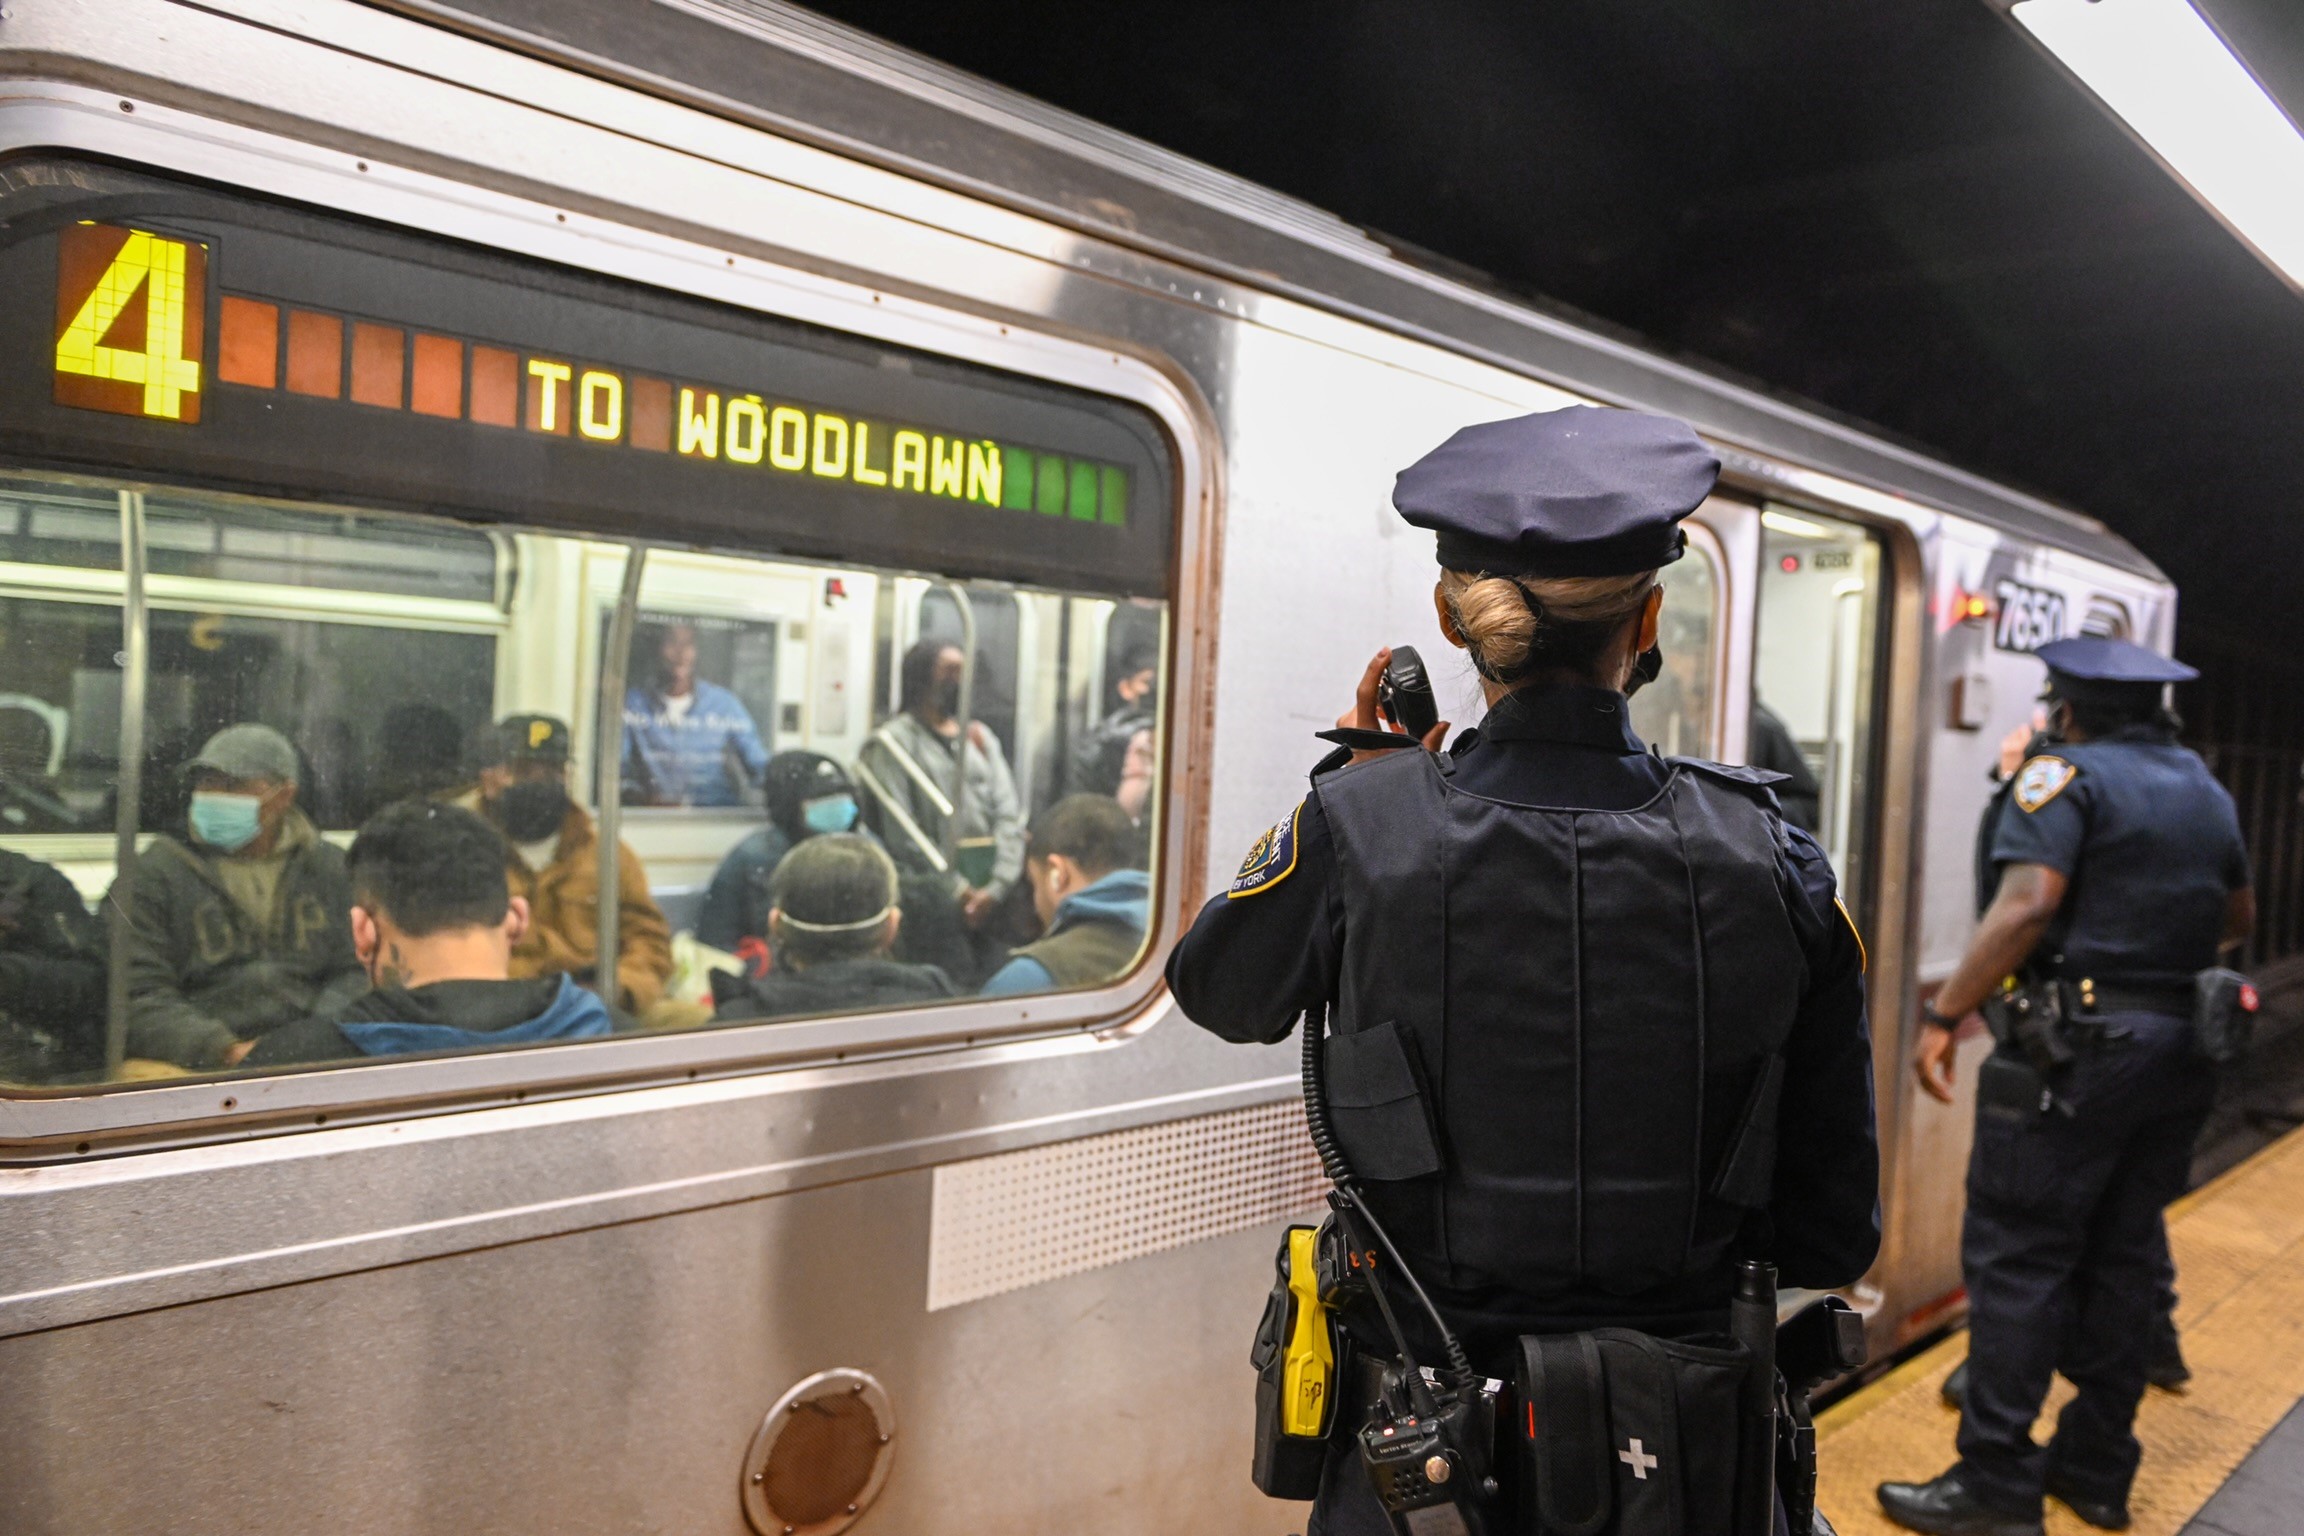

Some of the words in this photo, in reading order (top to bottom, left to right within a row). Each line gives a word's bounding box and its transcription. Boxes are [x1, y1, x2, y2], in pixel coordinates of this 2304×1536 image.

[55, 229, 200, 419] 4
[528, 359, 623, 440] TO
[677, 388, 1001, 507] WOODLAWN
[1242, 869, 1266, 888] YORK
